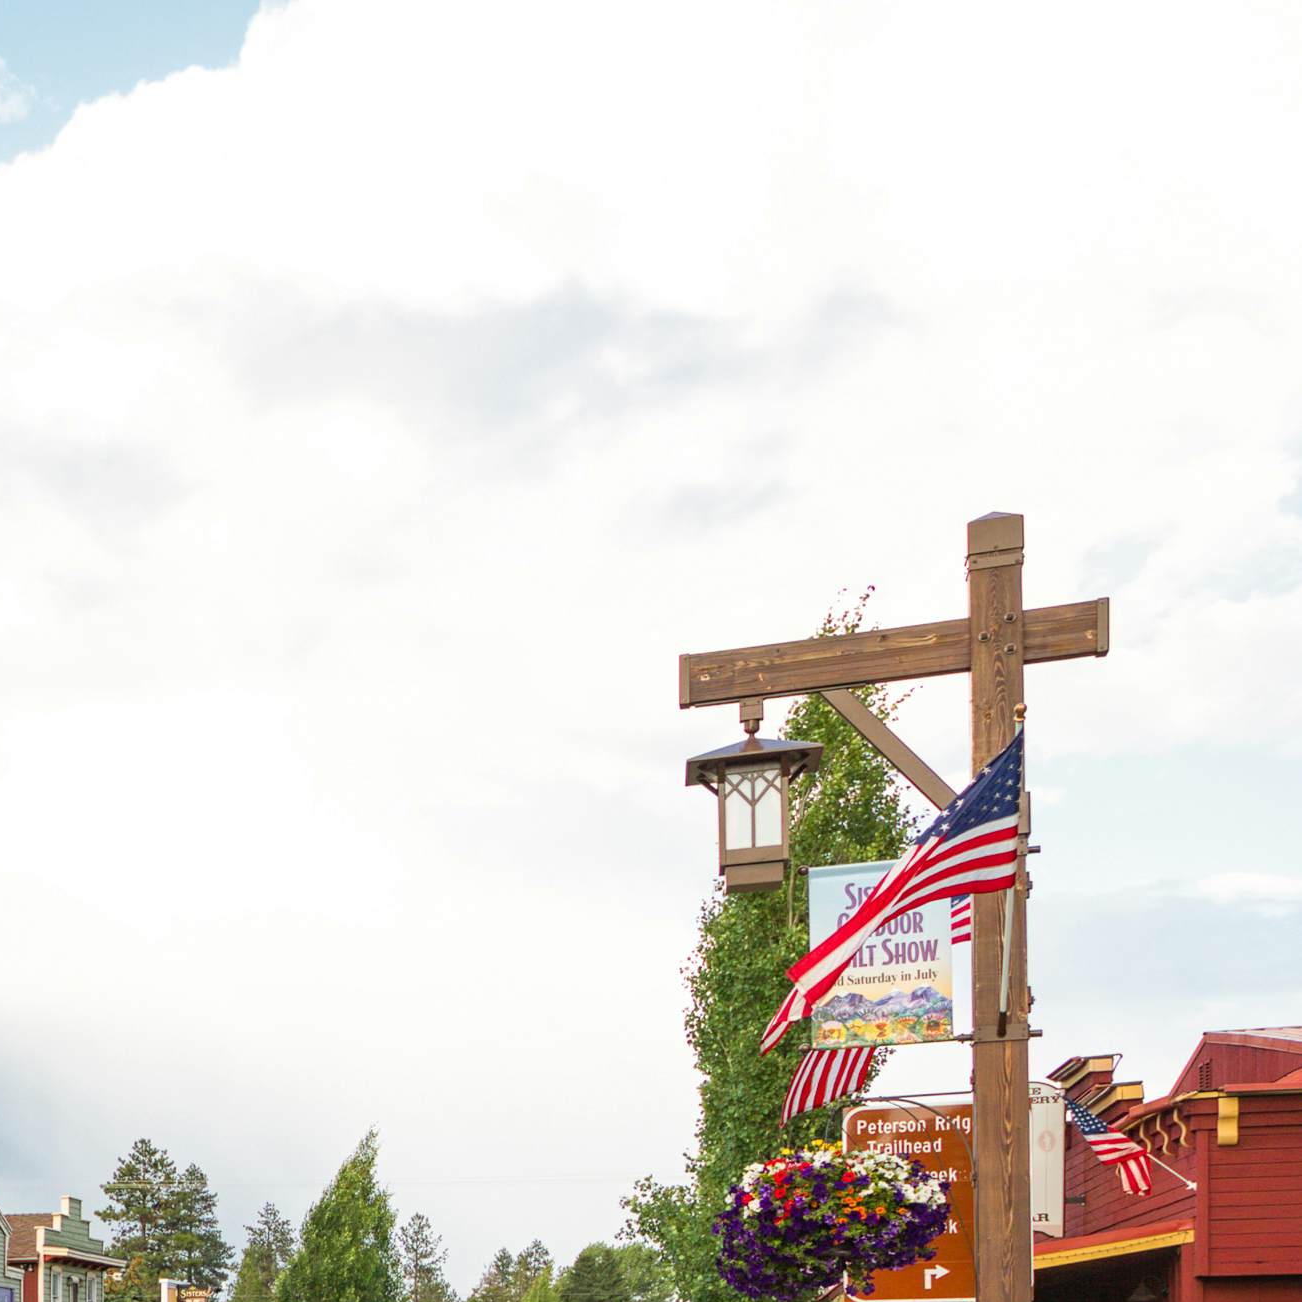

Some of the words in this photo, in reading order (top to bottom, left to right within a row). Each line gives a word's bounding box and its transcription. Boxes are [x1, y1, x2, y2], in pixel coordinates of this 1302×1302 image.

[881, 938, 939, 966] SHOW
[847, 971, 896, 986] Saturday
[901, 970, 912, 981] in
[914, 968, 939, 982] July
[856, 1118, 927, 1136] Peterson
[935, 1115, 972, 1134] Ridg
[867, 1138, 943, 1155] Trailhead
